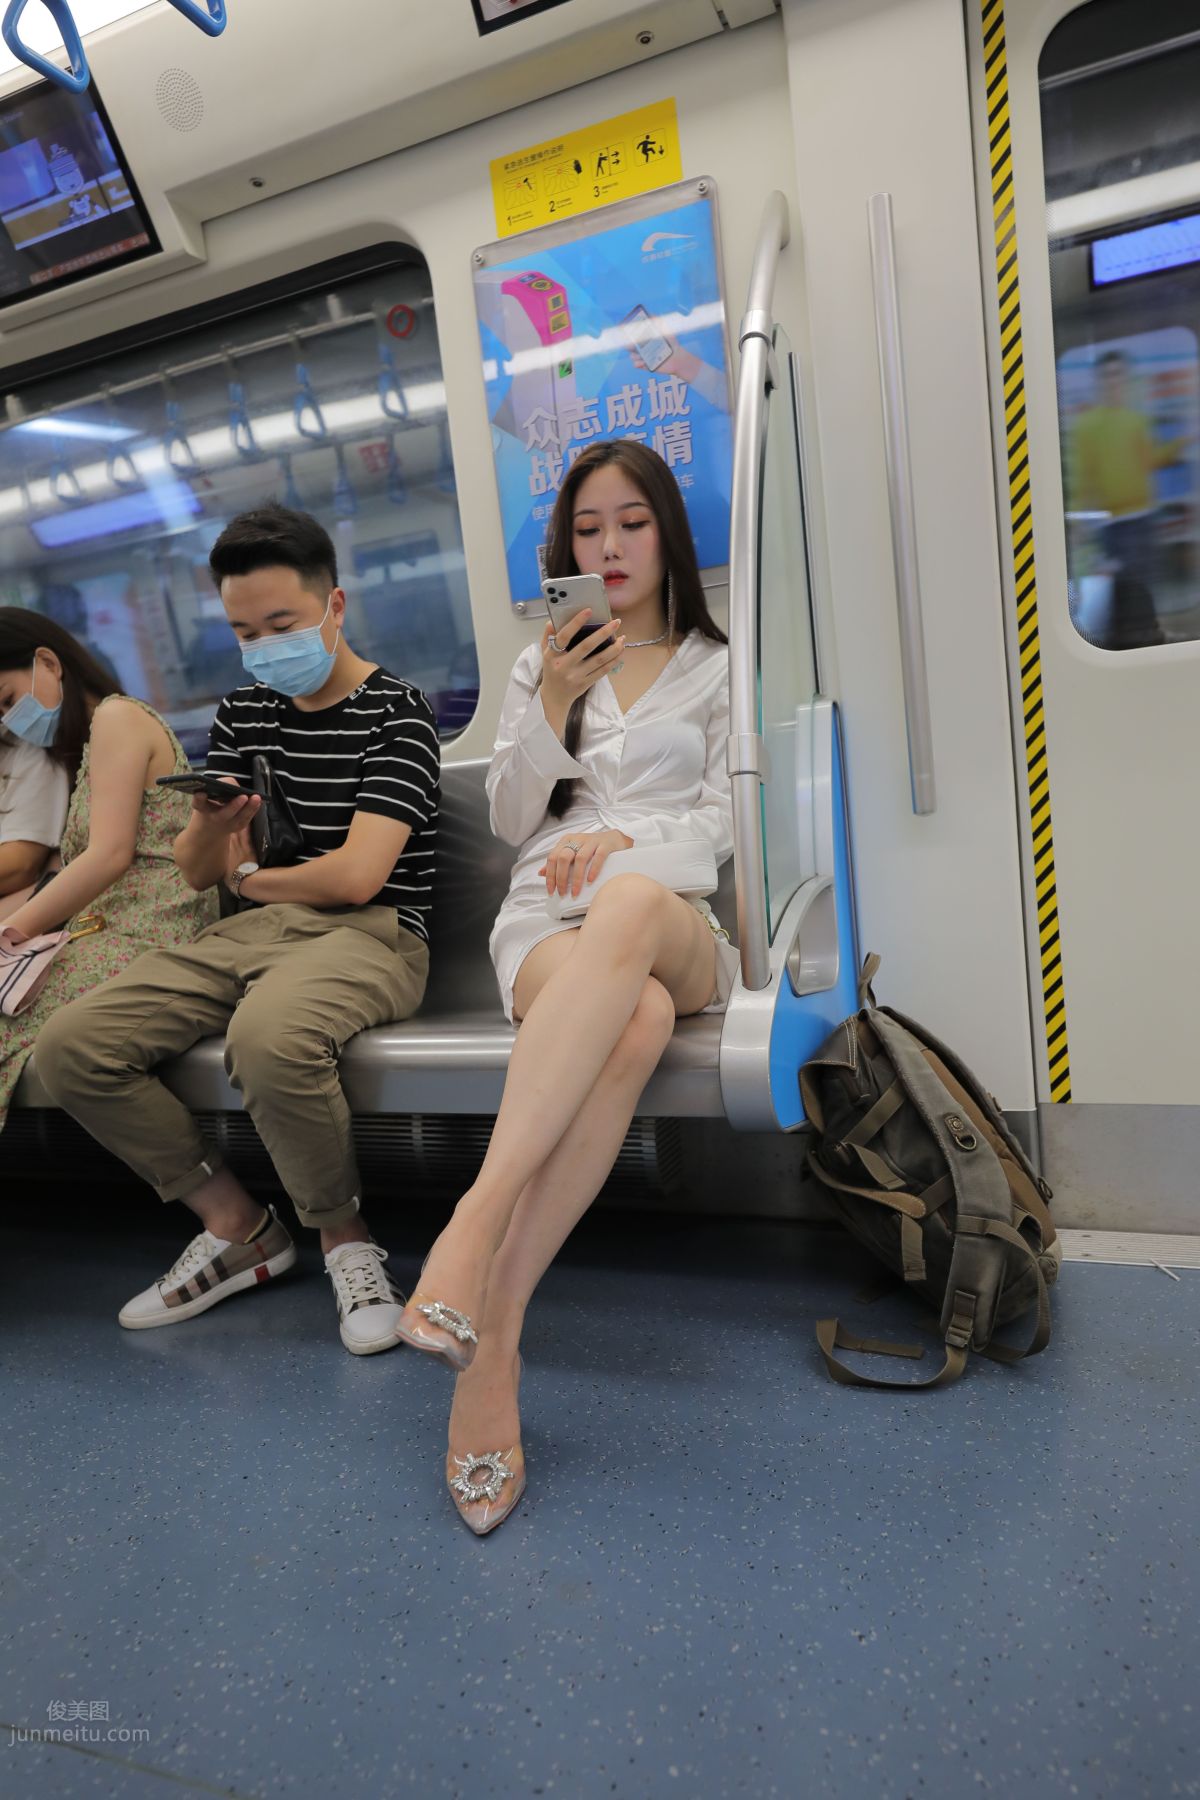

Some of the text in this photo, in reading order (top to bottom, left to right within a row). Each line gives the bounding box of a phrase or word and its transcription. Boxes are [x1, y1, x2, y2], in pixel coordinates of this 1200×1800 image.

[593, 186, 600, 197] 3
[549, 201, 556, 212] 2
[522, 375, 693, 452] 众志成城
